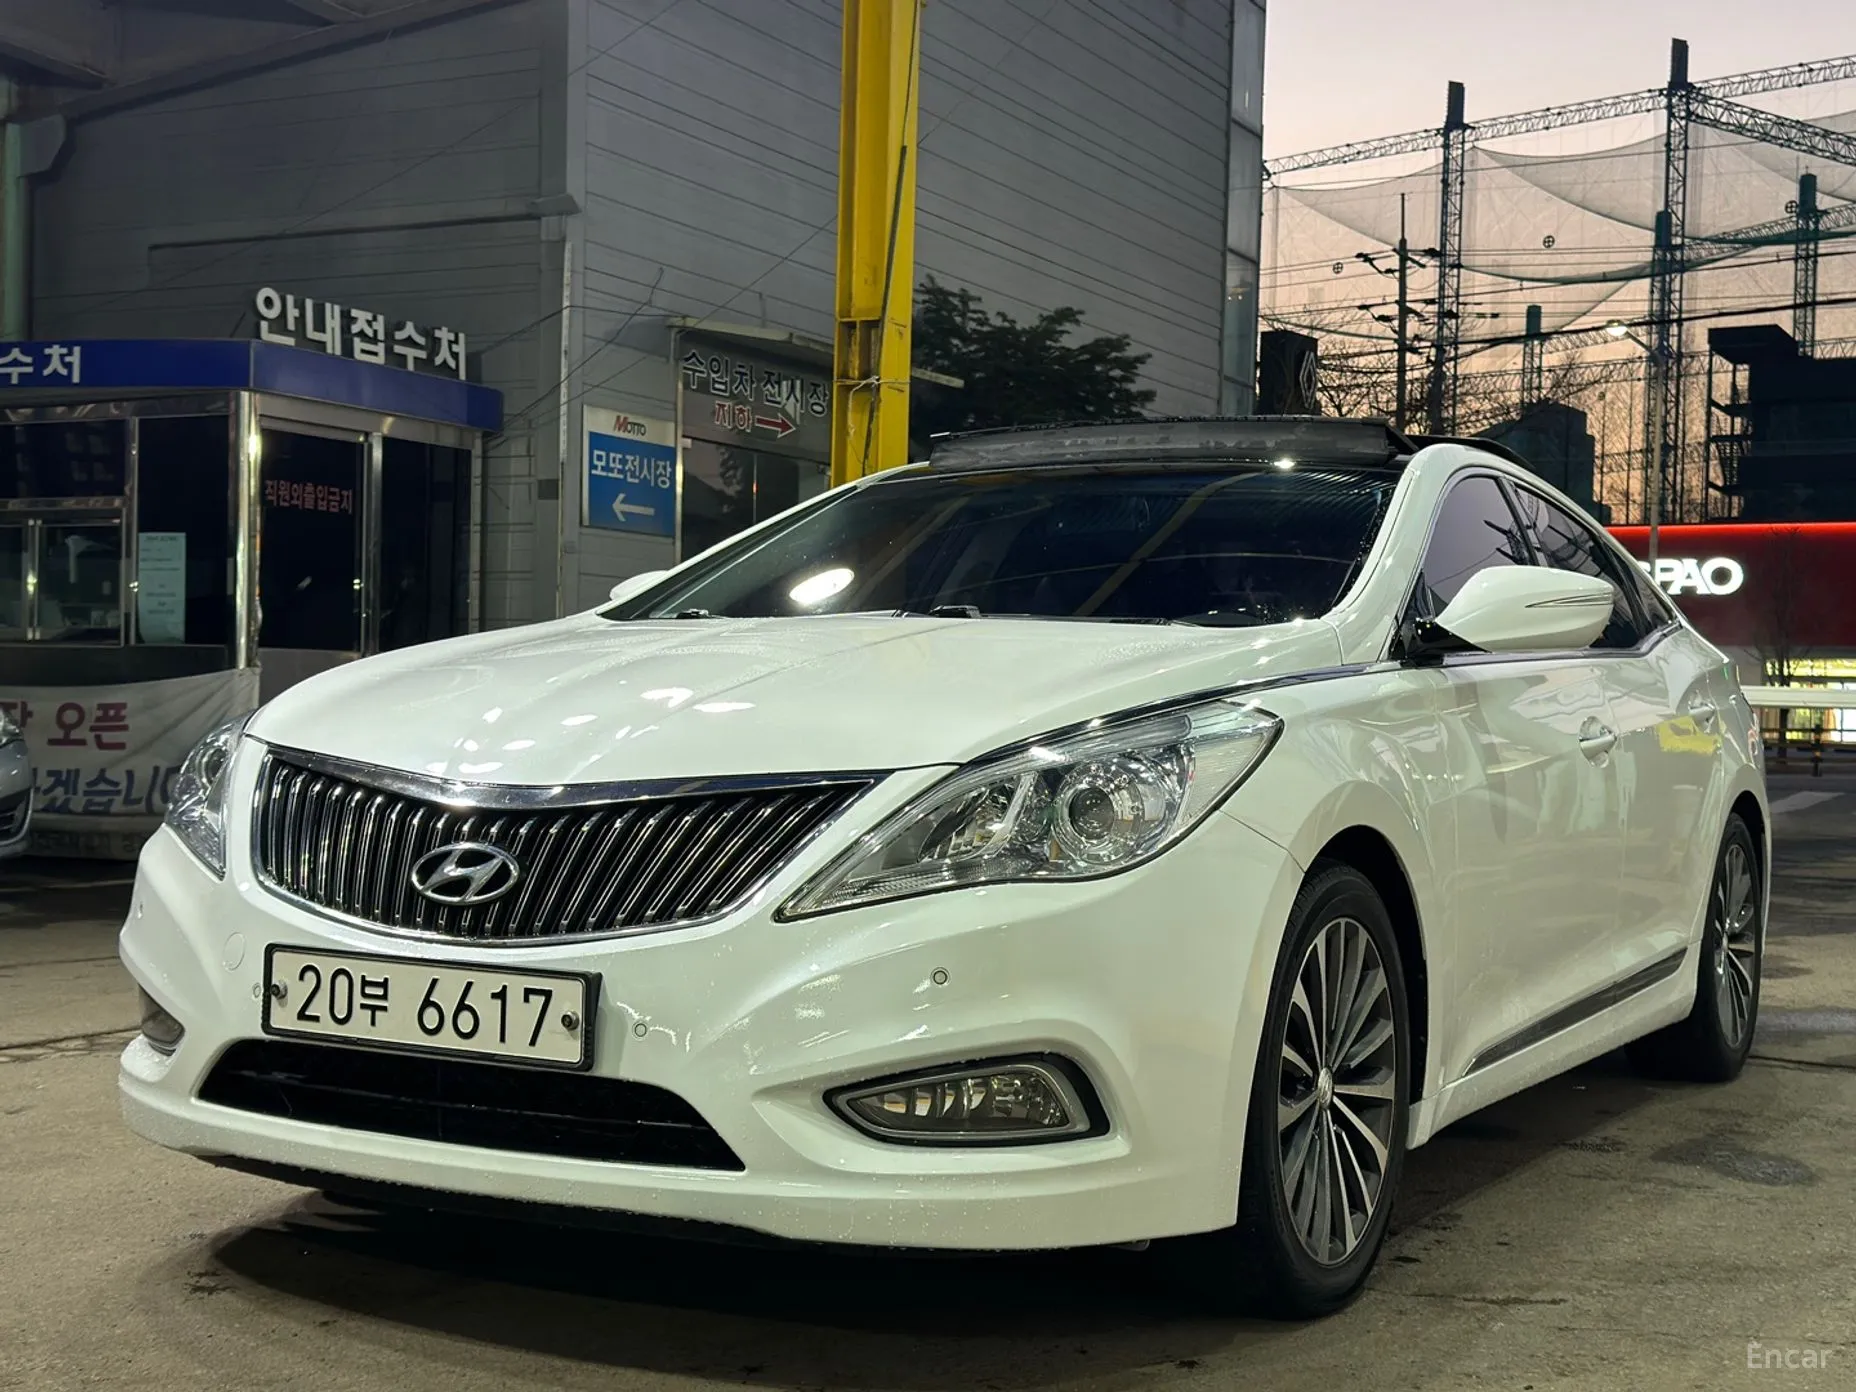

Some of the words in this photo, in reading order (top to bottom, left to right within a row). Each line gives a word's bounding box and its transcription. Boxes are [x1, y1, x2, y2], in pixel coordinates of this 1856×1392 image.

[255, 287, 466, 380] 안내접수처
[682, 349, 757, 402] 수입차
[762, 370, 829, 417] 전시장
[714, 400, 752, 433] 지하
[591, 449, 672, 489] 모또전시장
[47, 702, 129, 750] 오픈
[296, 963, 389, 1028] 20부
[417, 977, 554, 1048] 6617
